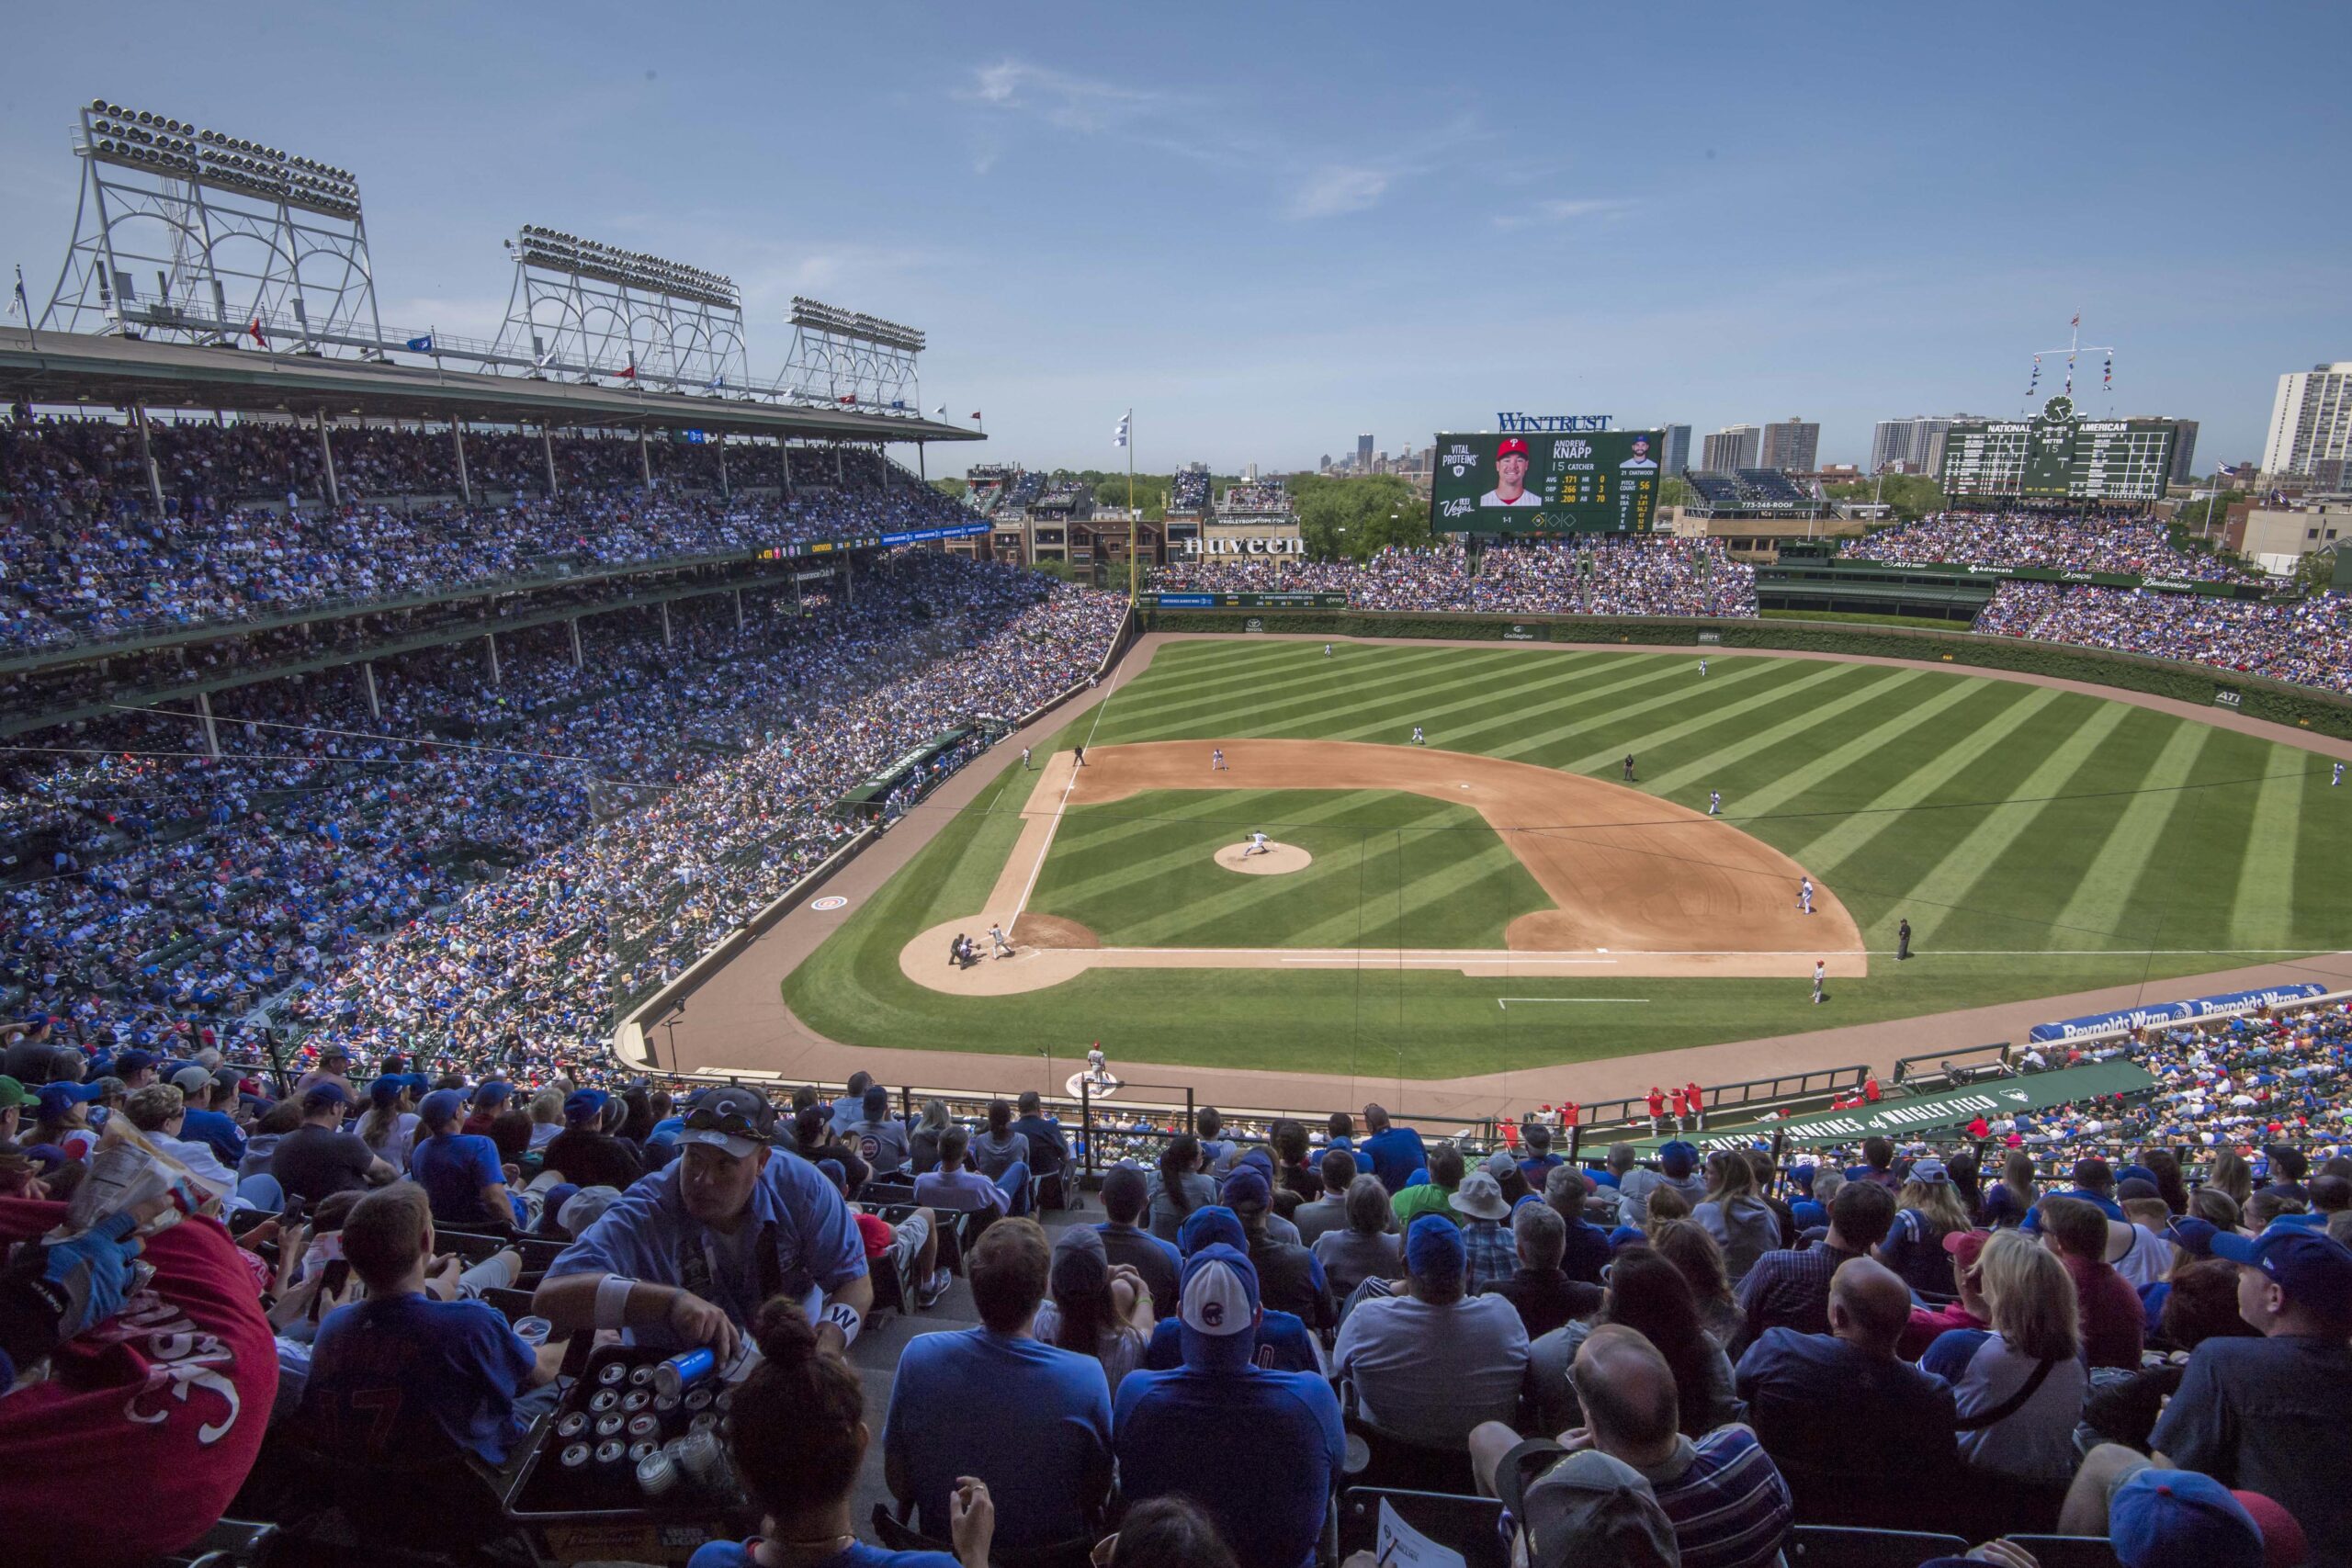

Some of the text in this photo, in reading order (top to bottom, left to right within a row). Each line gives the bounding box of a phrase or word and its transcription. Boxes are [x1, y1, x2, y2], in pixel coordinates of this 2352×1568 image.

[1498, 412, 1612, 432] WINTRUST
[1987, 424, 2031, 433] NATIONAL
[2079, 423, 2127, 432] AMERICAN
[1555, 439, 1587, 447] ANDREW
[1452, 445, 1470, 455] VITAL
[1553, 446, 1592, 458] KNAPP
[1442, 454, 1477, 467] PROTEINS
[1553, 461, 1565, 471] 15
[1562, 476, 1577, 484] .171
[1561, 485, 1577, 493] .266
[1599, 485, 1604, 493] 3
[1639, 480, 1650, 491] 56
[1560, 495, 1576, 503] .200
[1596, 495, 1606, 503] 70
[1440, 499, 1476, 518] Vegas
[1183, 536, 1306, 554] nuveen
[797, 571, 820, 581] Assurance
[2071, 571, 2092, 580] pepsi
[2142, 577, 2193, 589] Budweiser
[1326, 596, 1346, 604] xfinity
[2216, 691, 2241, 704] ATI
[2200, 994, 2261, 1015] Reynolds
[2063, 1010, 2131, 1038] Reynolds
[1868, 1113, 1888, 1132] of
[1879, 1100, 1954, 1125] WRIGLEY
[1947, 1095, 1998, 1116] FIELD
[831, 1306, 857, 1330] W
